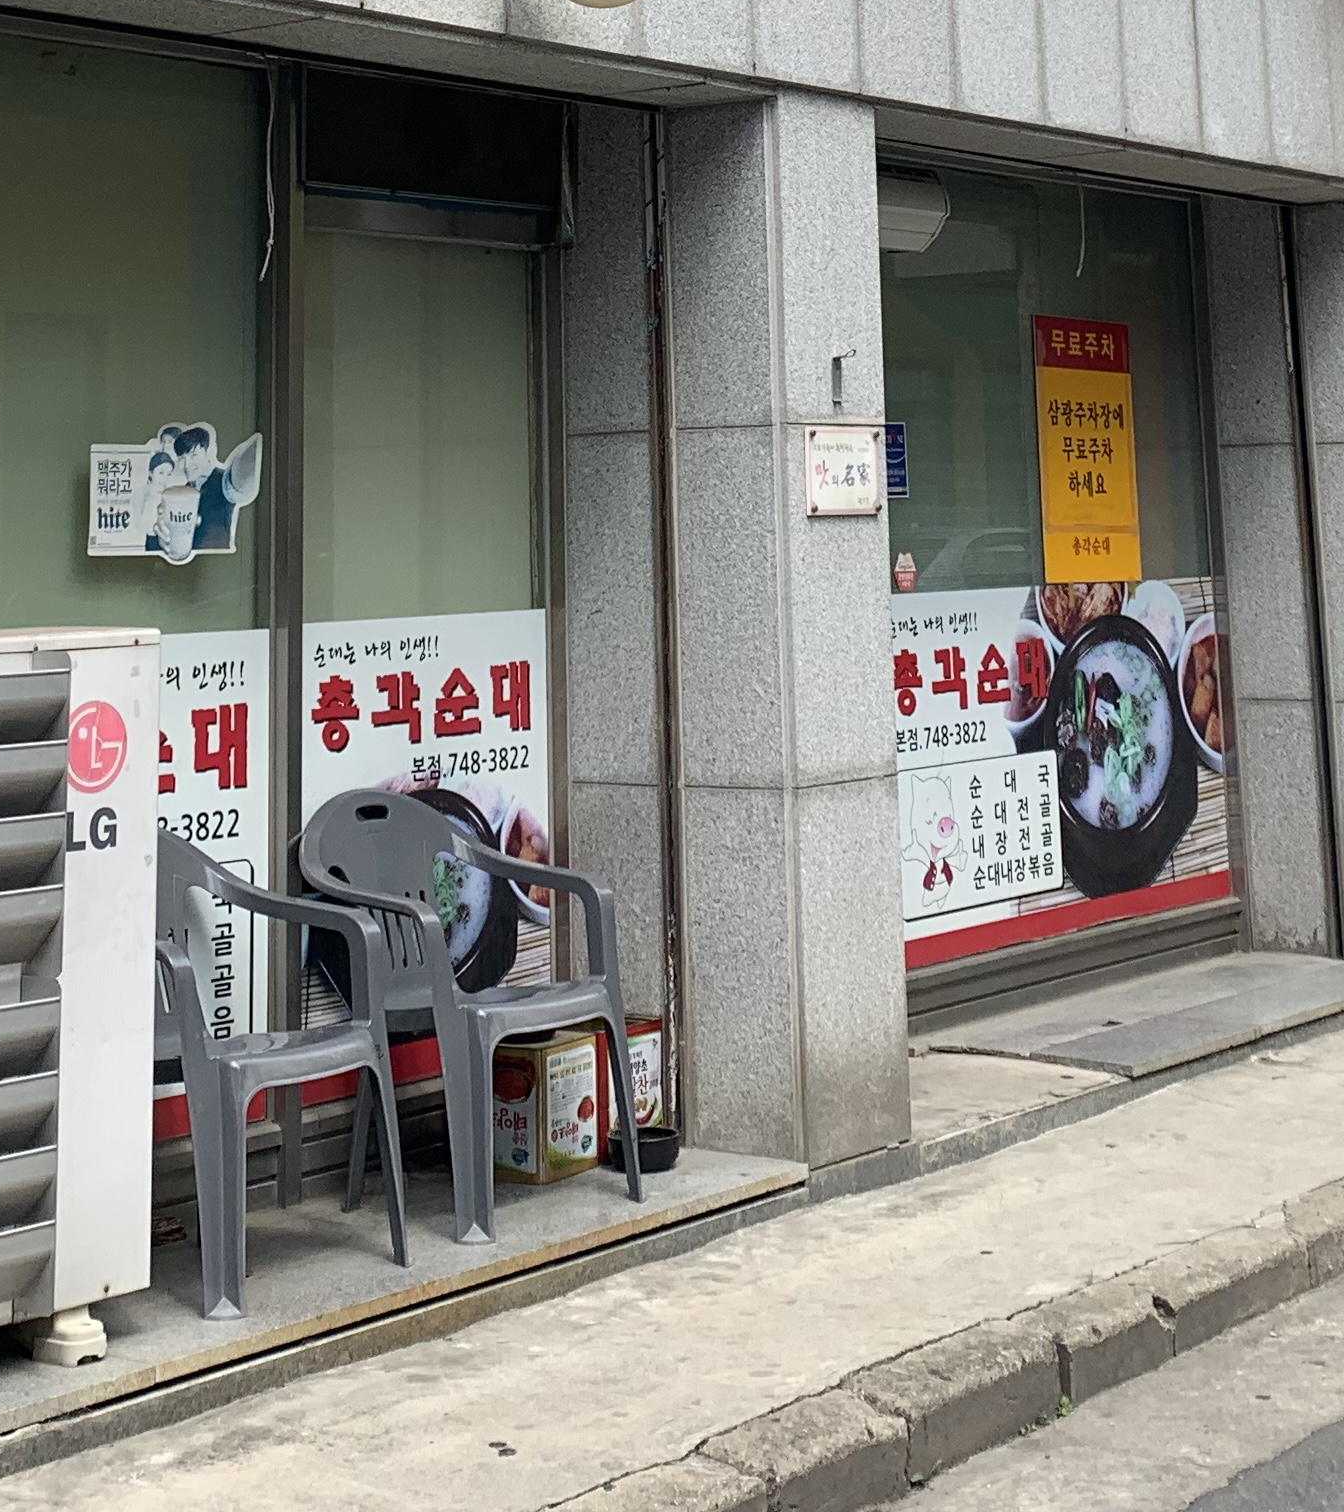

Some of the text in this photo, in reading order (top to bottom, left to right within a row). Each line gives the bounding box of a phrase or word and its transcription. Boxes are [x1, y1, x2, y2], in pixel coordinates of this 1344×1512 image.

[1051, 329, 1115, 360] 무료주차
[1047, 399, 1124, 430] 삼광주차장에
[1062, 437, 1113, 464] 무료주차
[97, 459, 132, 478] 맥주가
[97, 478, 132, 495] 뭐라고
[1068, 471, 1107, 498] 하세요
[97, 506, 131, 529] hite
[169, 510, 193, 523] hite
[1072, 536, 1110, 556] 총각순대
[924, 615, 944, 634] 나의
[949, 612, 978, 635] 인생!!
[313, 635, 440, 668] 순대는 나의 인생!!
[192, 660, 246, 693] 인생!!
[893, 638, 1049, 716] 총각순대
[310, 659, 533, 754] 총각순대
[66, 806, 118, 852] LG
[973, 852, 1055, 890] 순대내장볶음
